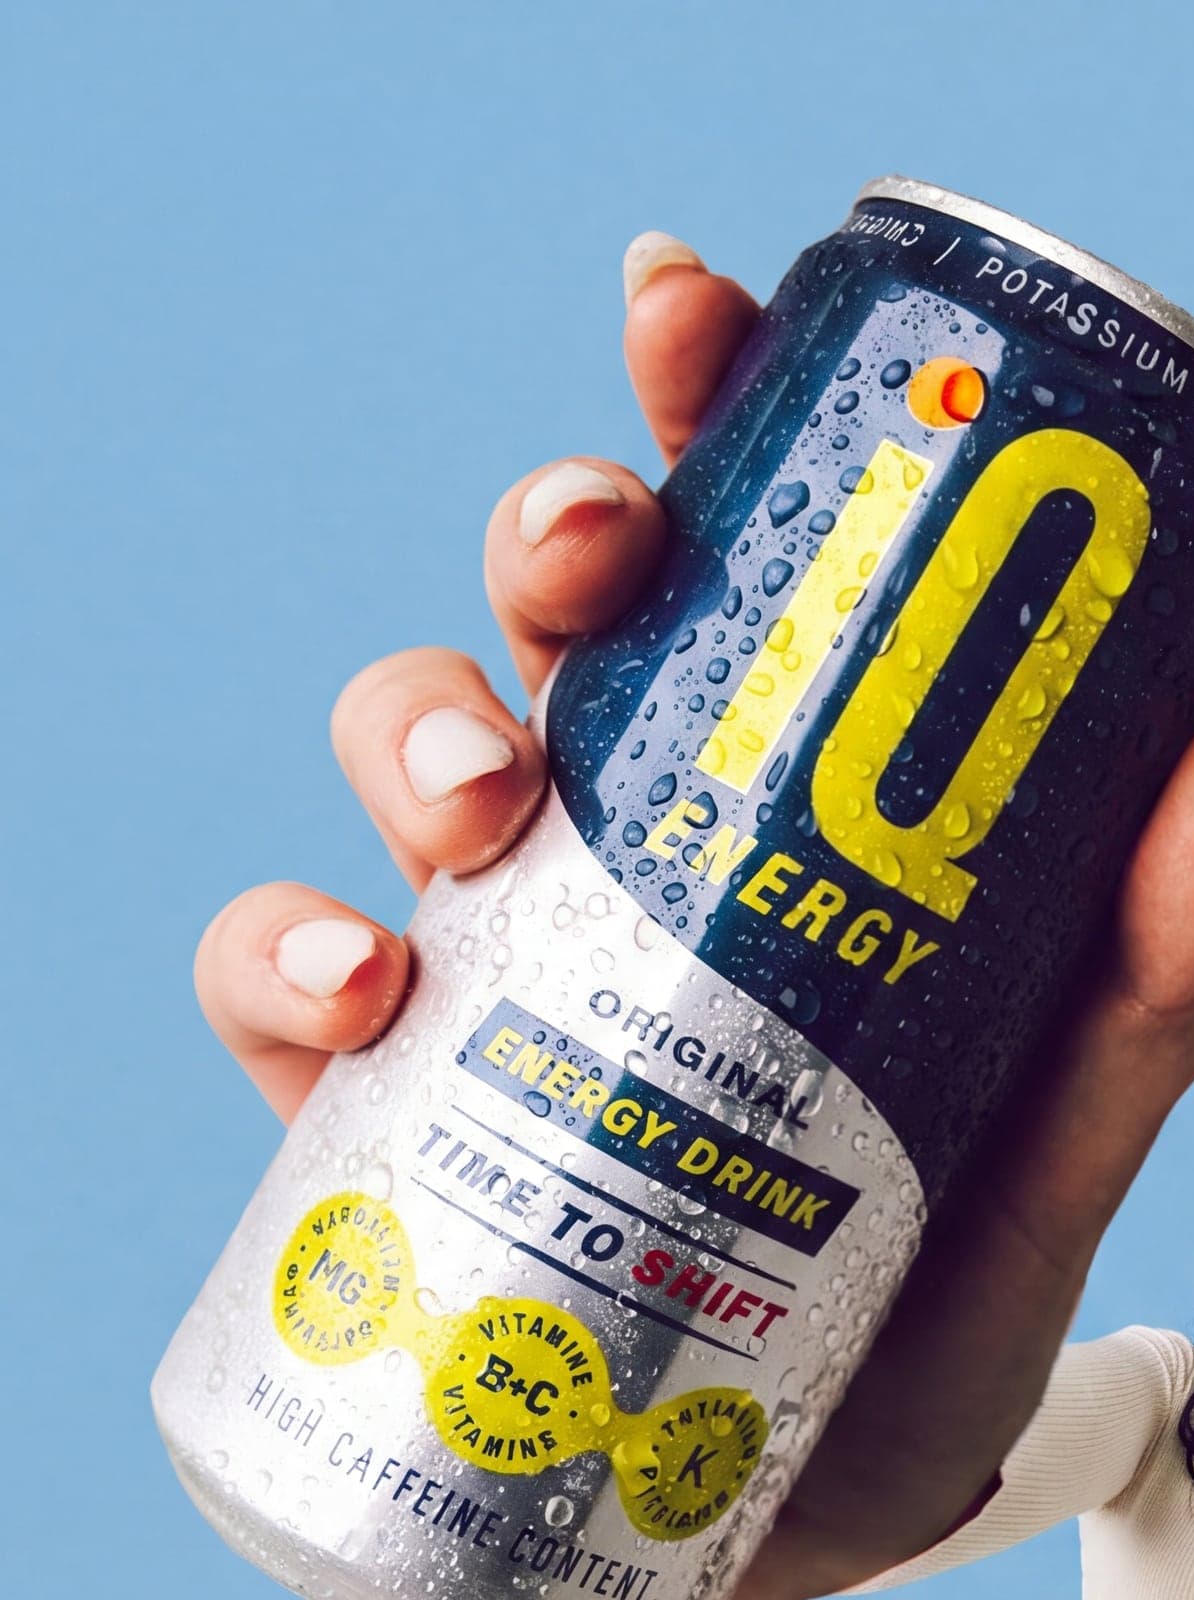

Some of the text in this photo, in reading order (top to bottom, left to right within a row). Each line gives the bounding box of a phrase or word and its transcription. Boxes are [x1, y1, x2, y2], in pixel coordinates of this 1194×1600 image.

[976, 256, 1189, 394] POTASSIUM
[642, 798, 940, 985] ENERGY
[481, 1026, 831, 1231] ENERGY DRINK
[588, 988, 811, 1131] ORIGINAL
[308, 1248, 367, 1306] MG
[416, 1123, 789, 1340] TIME TO SHIFT
[475, 1352, 560, 1417] B+C
[478, 1312, 593, 1388] VITAMINE
[246, 1374, 324, 1448] HIGH
[328, 1432, 505, 1549] CAFFEINE
[676, 1443, 721, 1489] K
